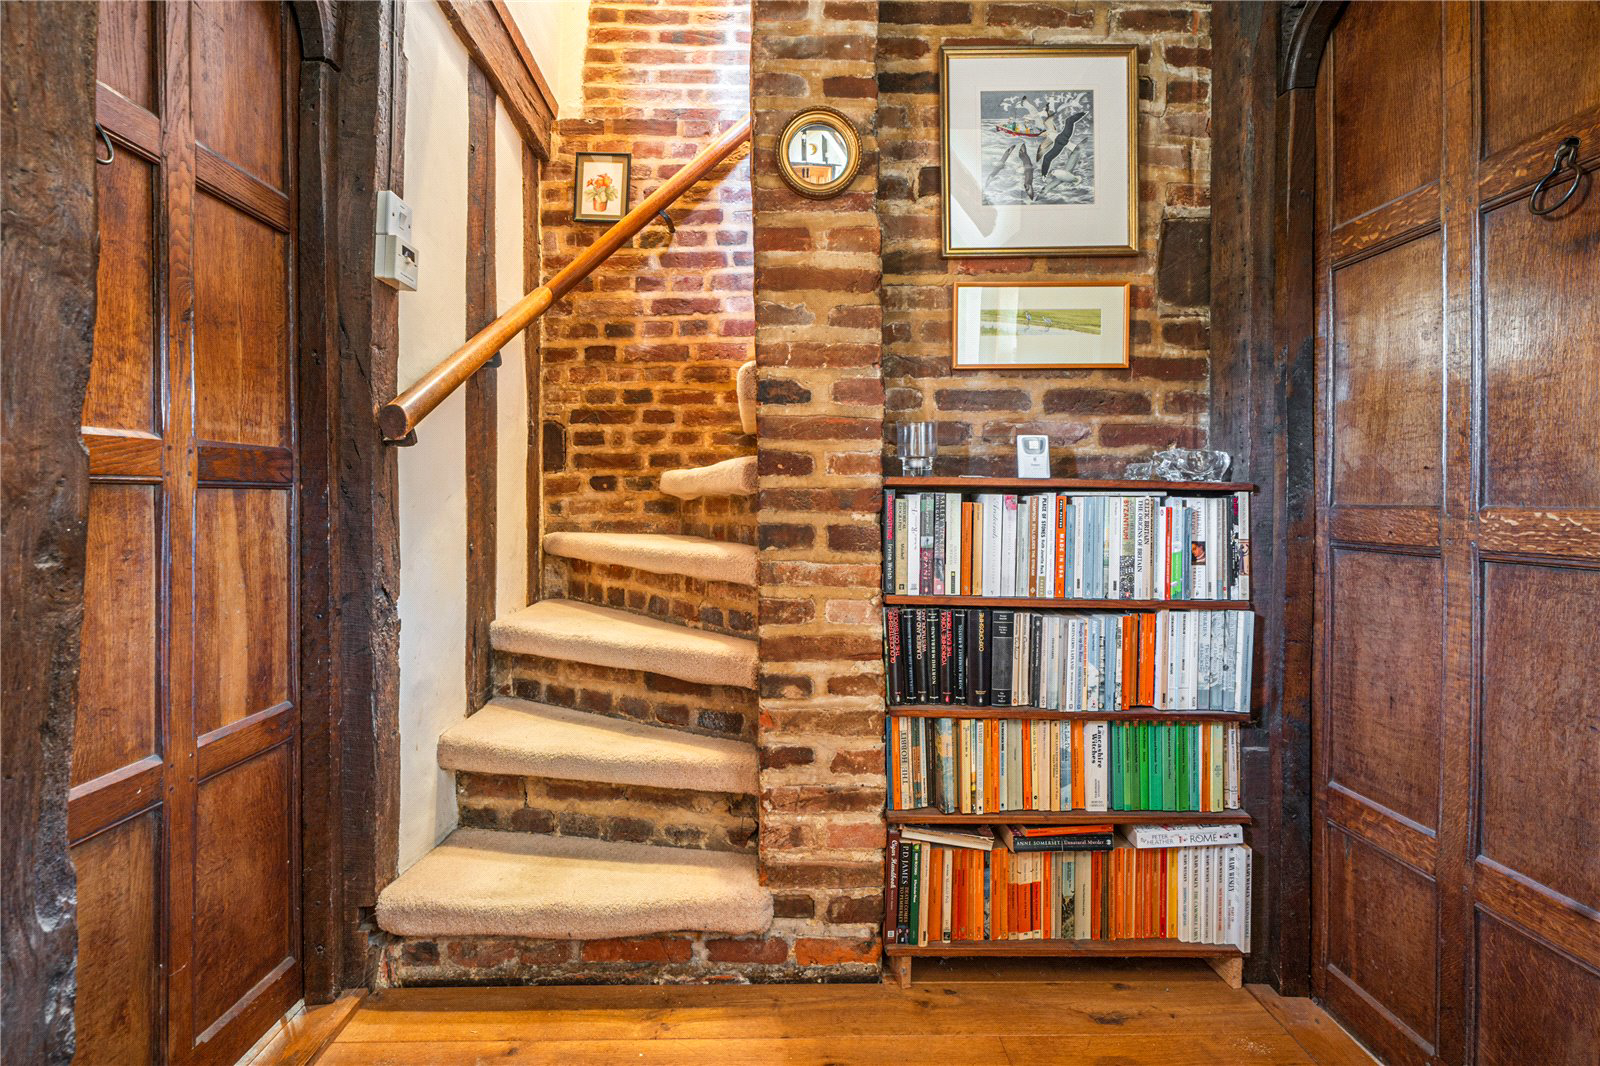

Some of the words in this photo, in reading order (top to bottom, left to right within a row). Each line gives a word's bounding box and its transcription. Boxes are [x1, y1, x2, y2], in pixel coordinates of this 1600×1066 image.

[1190, 834, 1218, 843] ROME
[890, 840, 898, 856] Cigar
[902, 846, 910, 858] P.D.
[890, 858, 898, 889] Handbook
[902, 860, 910, 885] JAMES
